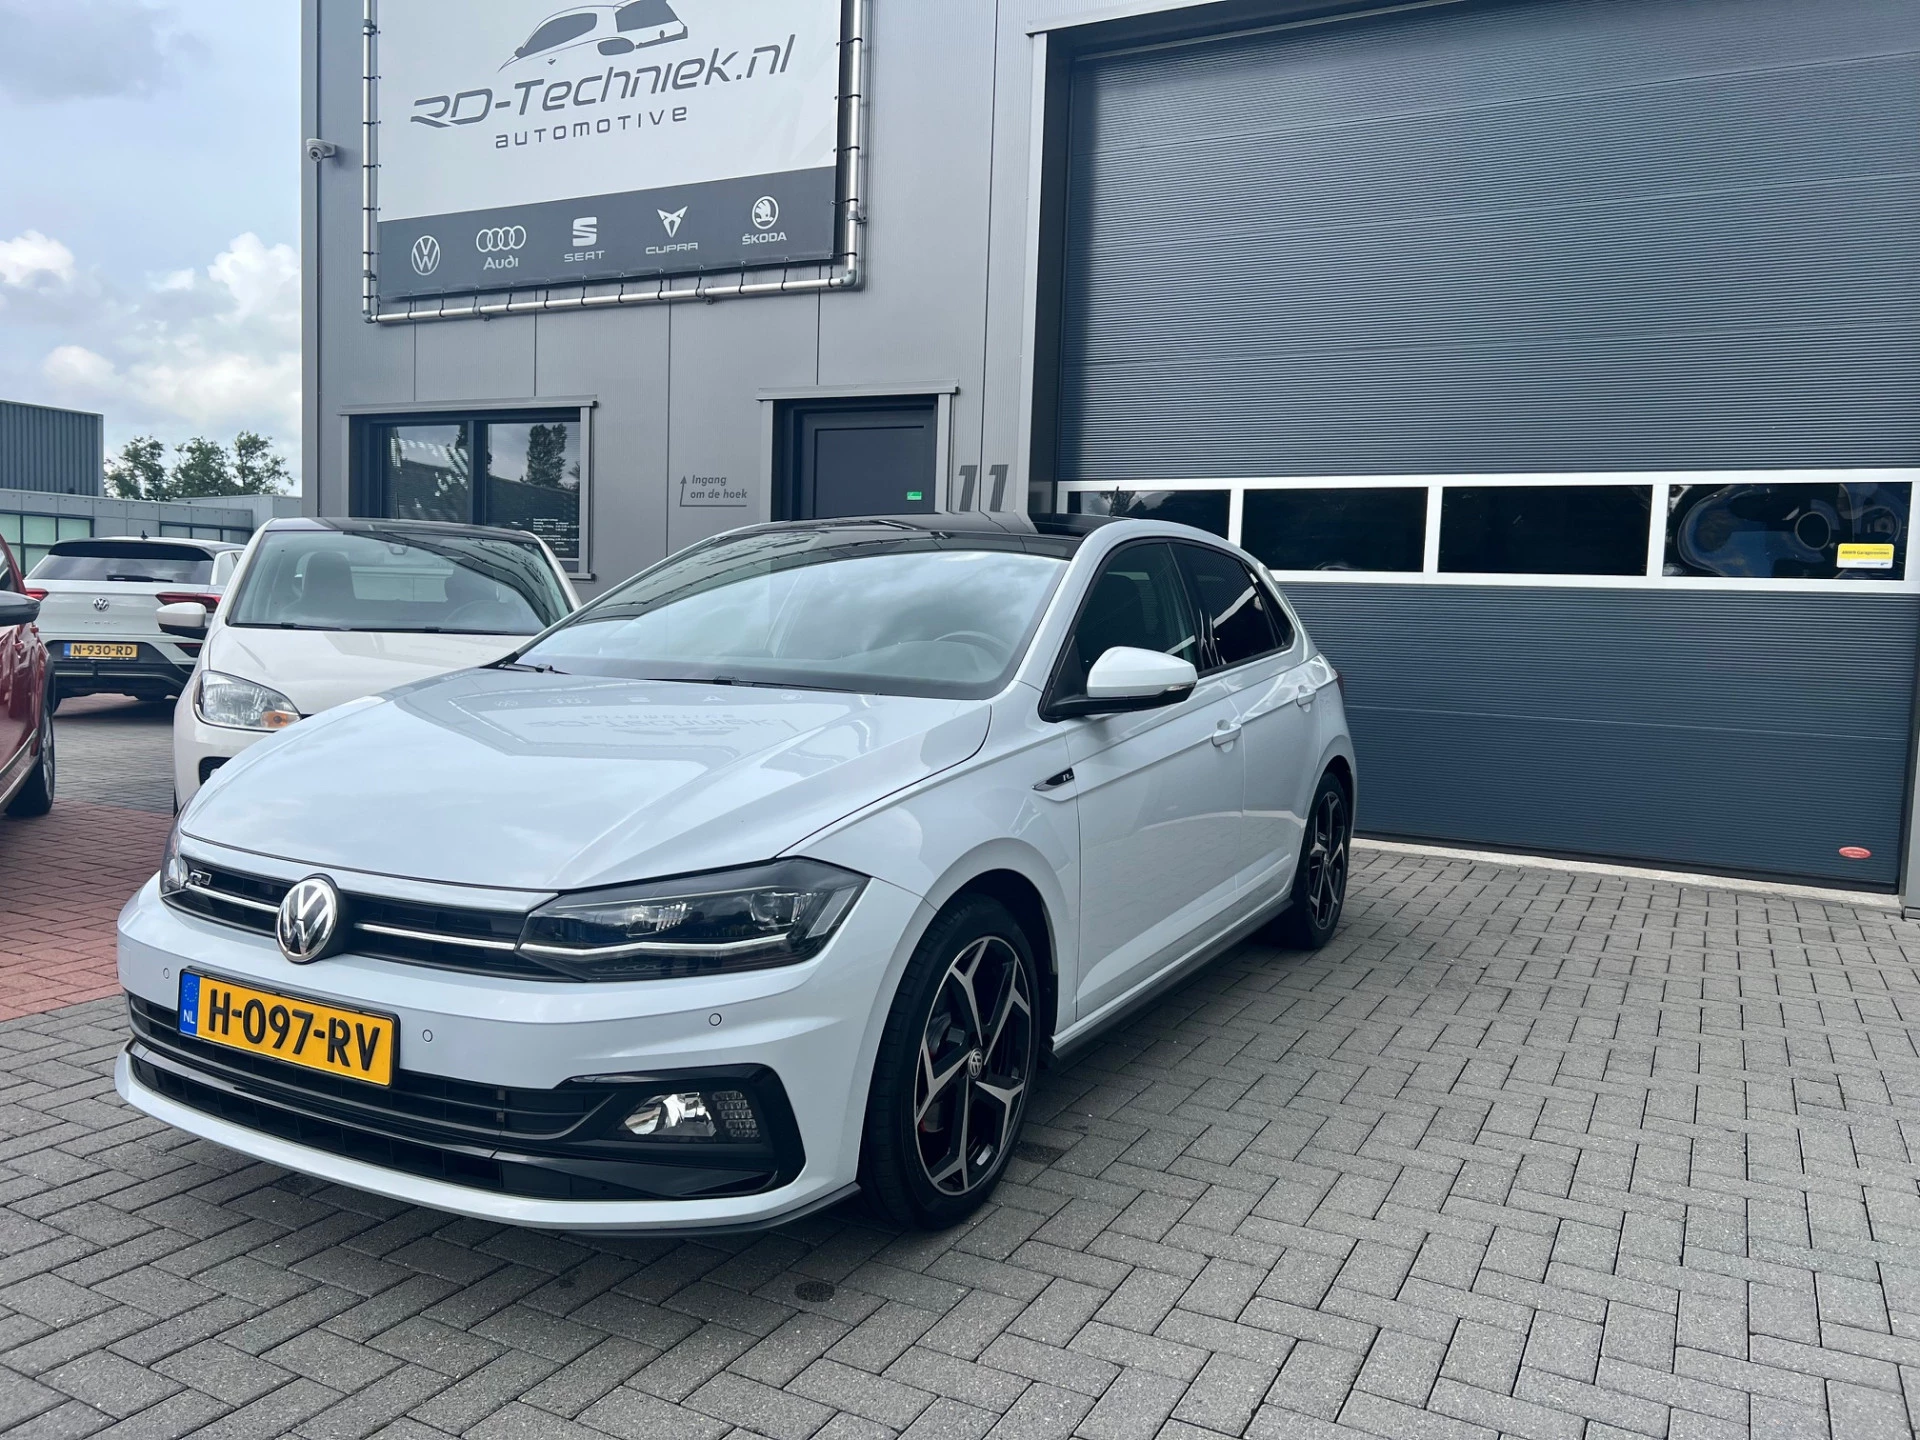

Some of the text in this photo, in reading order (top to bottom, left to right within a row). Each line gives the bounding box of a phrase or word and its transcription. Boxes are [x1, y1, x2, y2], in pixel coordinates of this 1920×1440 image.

[410, 34, 796, 128] RD-Techniek.nl
[742, 231, 787, 245] ŠKODA
[645, 242, 699, 255] CUPRA
[483, 255, 519, 270] Audi
[564, 250, 605, 262] SEAT
[692, 474, 727, 487] Ingang
[690, 488, 748, 499] om de hoek
[73, 644, 133, 656] N-930-RD
[183, 1010, 196, 1024] NL
[208, 988, 381, 1072] H-097-RV
